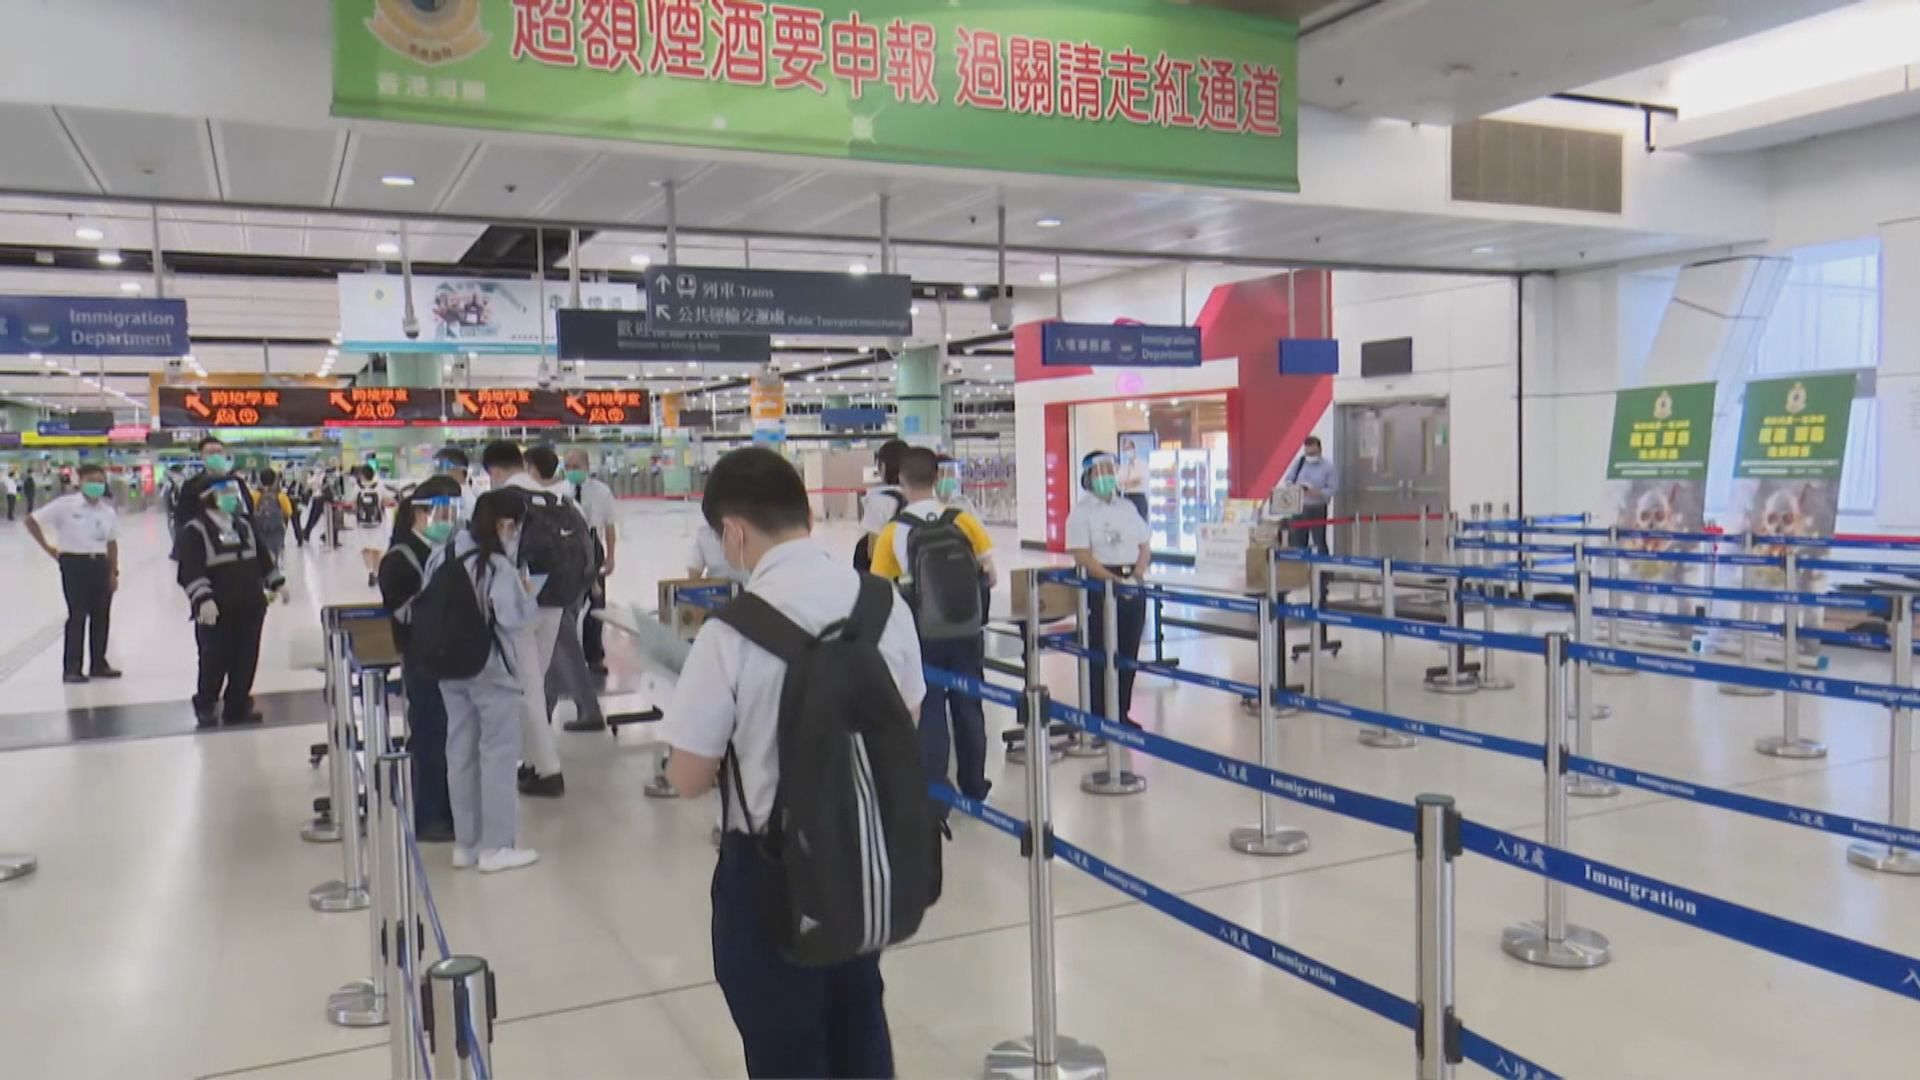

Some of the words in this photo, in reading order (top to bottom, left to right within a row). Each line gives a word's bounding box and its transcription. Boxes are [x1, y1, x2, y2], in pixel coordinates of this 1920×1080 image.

[511, 0, 938, 104] 超額煙酒要申報
[954, 26, 1282, 136] 過關請走紅通道
[740, 285, 775, 298] Trains
[69, 308, 175, 328] Immigration
[71, 329, 173, 348] Department
[1141, 333, 1195, 346] Immigration
[1142, 350, 1194, 361] Department
[1270, 774, 1336, 804] Immigration
[1495, 839, 1547, 872] 入境處
[1584, 863, 1698, 917] Immigration
[1271, 944, 1338, 987] Immigration
